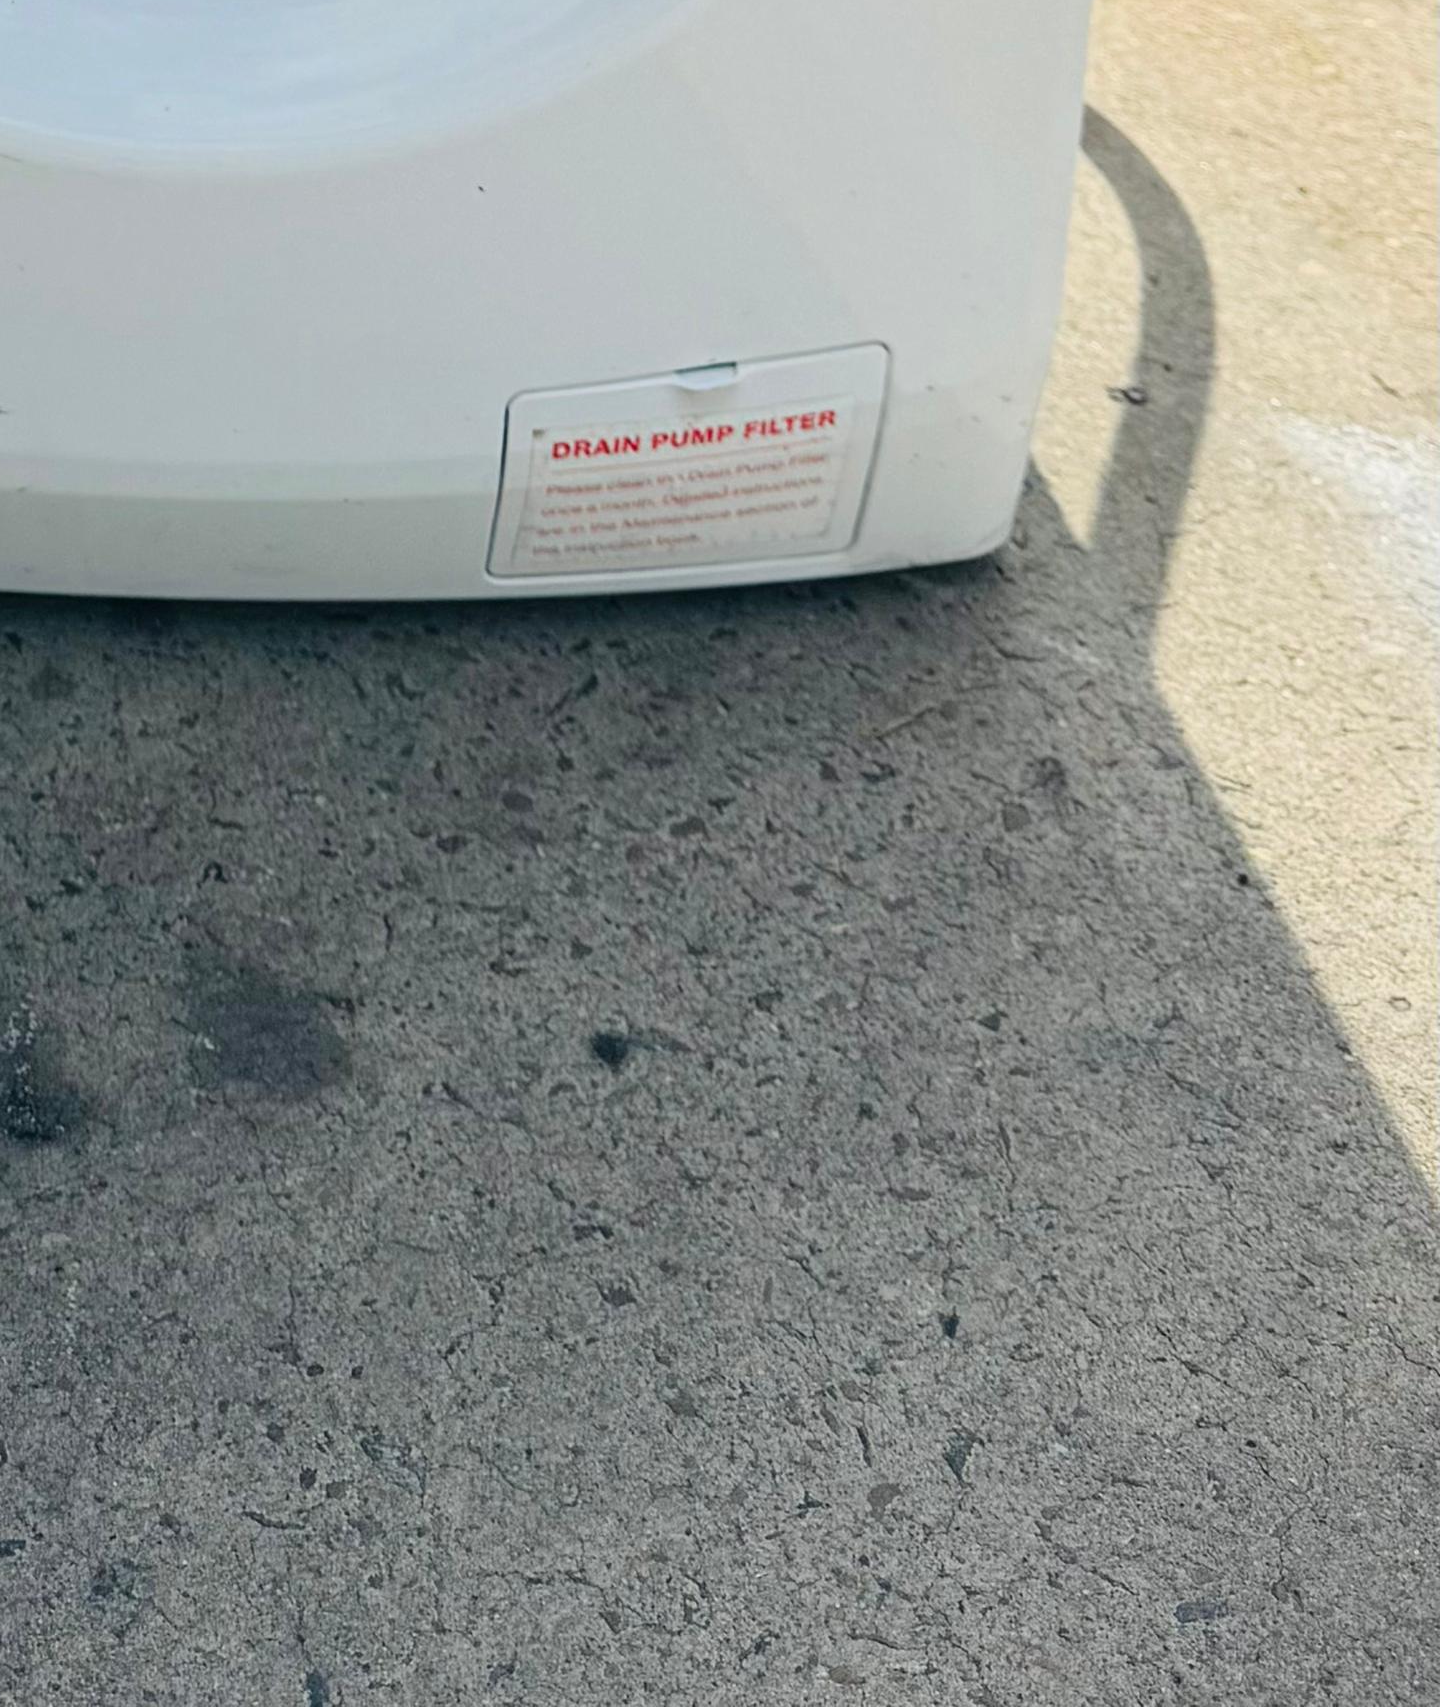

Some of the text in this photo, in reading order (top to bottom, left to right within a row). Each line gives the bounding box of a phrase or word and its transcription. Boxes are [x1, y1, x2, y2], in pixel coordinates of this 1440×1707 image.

[551, 409, 836, 460] DRAIN PUMP FILTER
